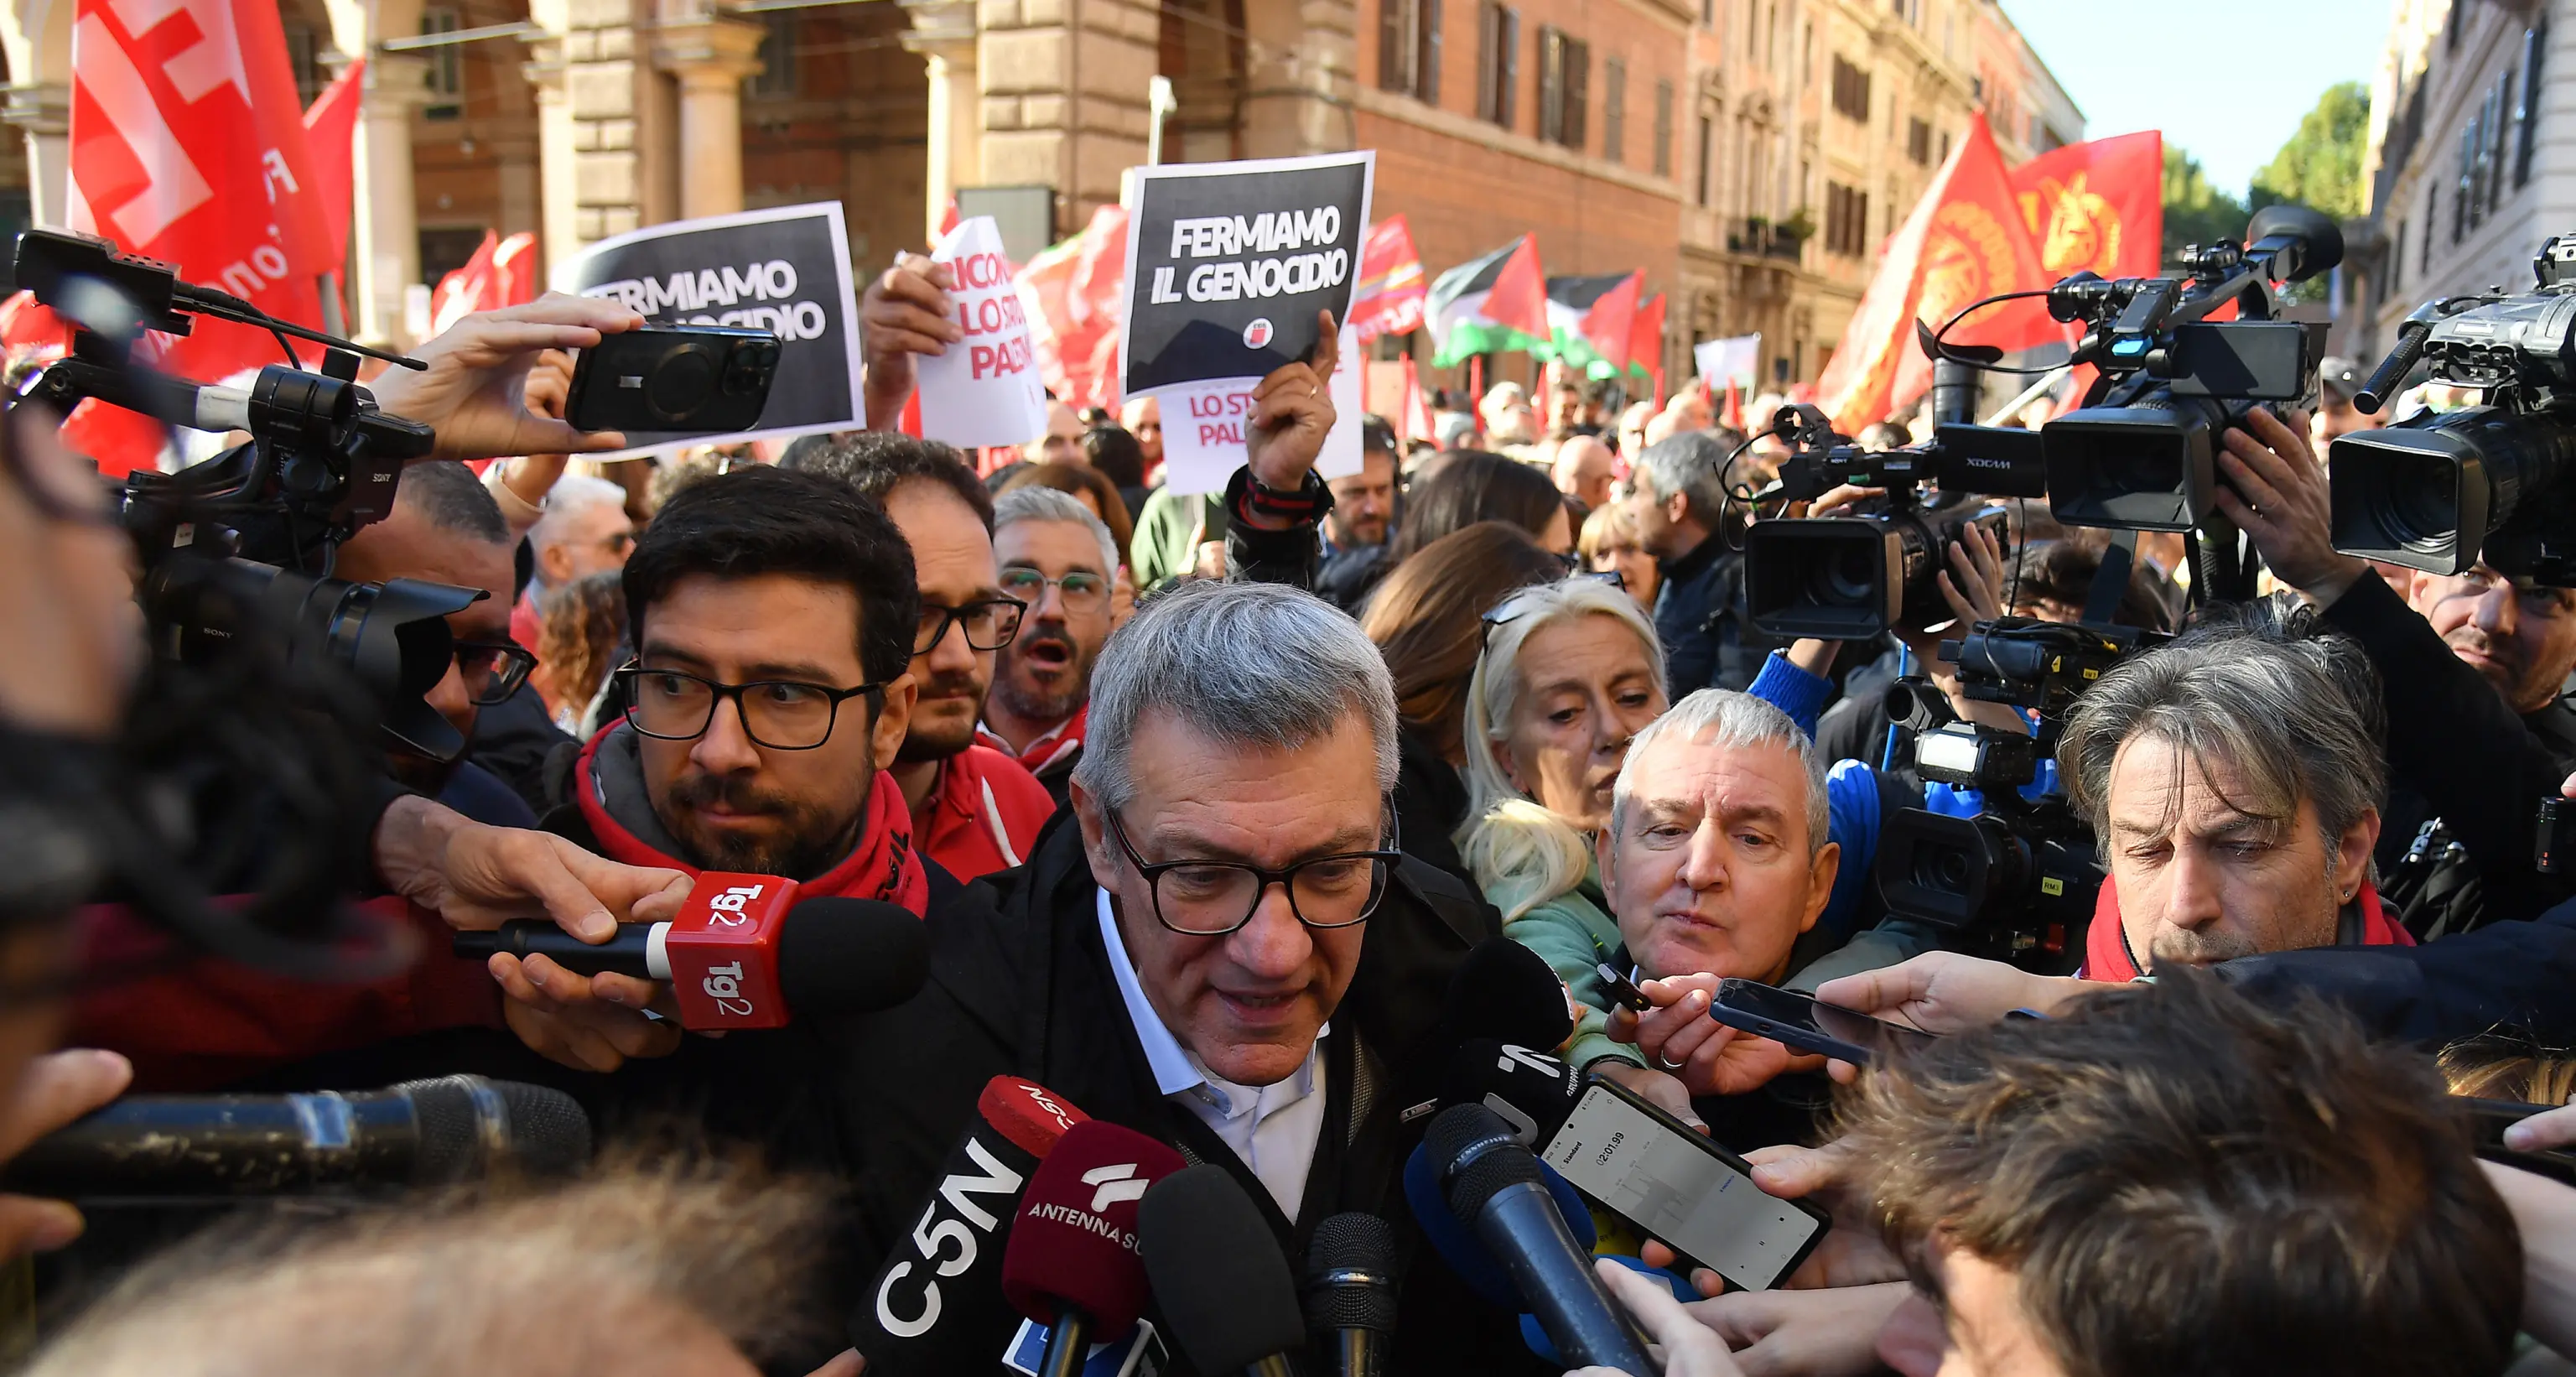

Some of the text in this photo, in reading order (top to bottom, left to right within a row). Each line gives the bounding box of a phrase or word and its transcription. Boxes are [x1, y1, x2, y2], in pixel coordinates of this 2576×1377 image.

[1170, 205, 1341, 259] FERMIAMO
[1150, 247, 1348, 304] IL GENOCIDIO
[959, 298, 1001, 335] LO
[1190, 395, 1222, 418] LO
[1966, 457, 2011, 470] XDCAM
[709, 884, 764, 927] Tg2
[703, 961, 753, 1016] Tg2
[1563, 1141, 1582, 1165] Standard
[1596, 1131, 1624, 1167] 02:01.99
[876, 1136, 1023, 1338] C5N
[1028, 1202, 1120, 1243] ANTENNA
